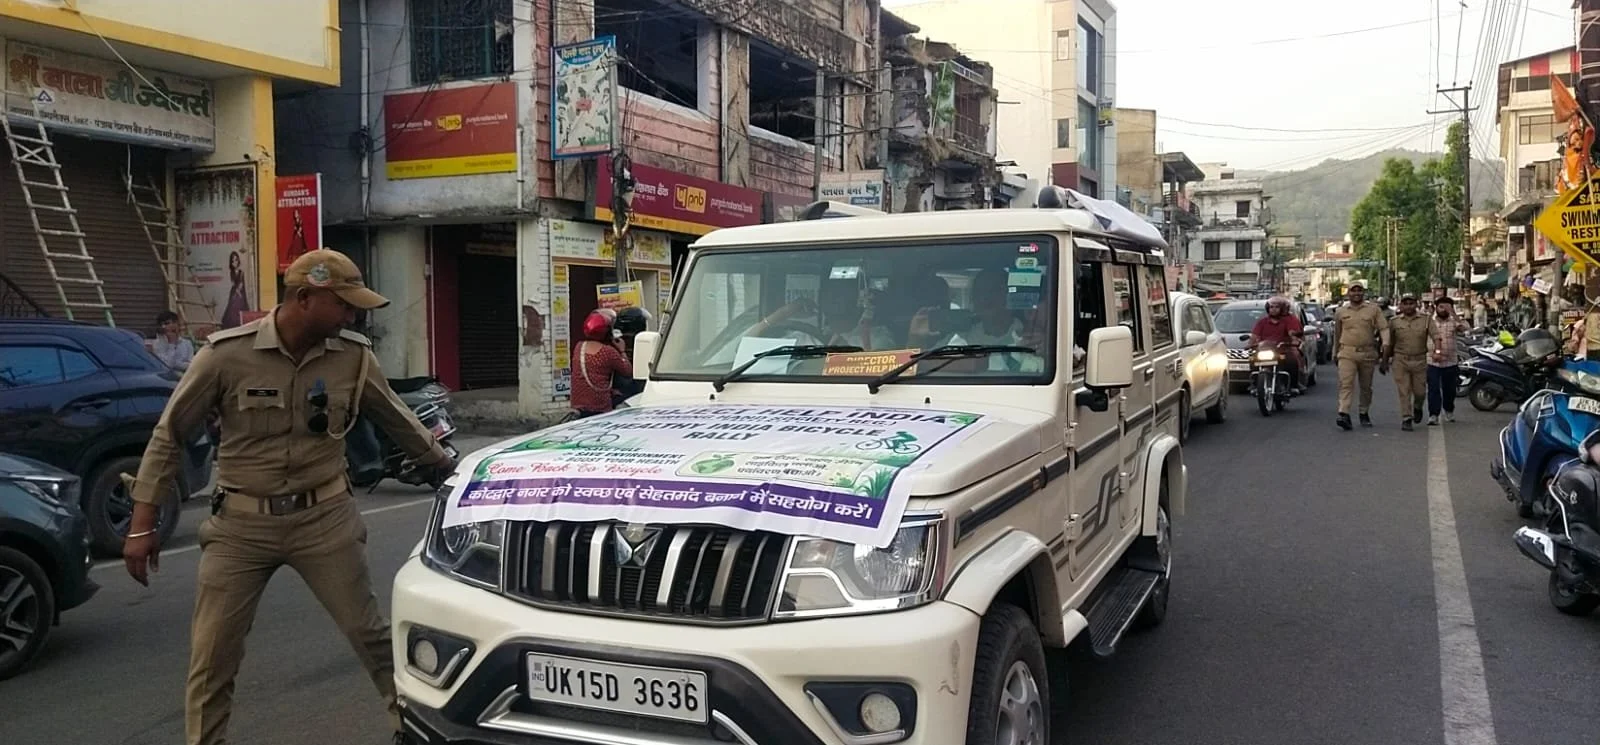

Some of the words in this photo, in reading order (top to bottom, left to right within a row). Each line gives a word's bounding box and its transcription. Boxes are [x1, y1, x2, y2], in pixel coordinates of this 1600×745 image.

[43, 67, 104, 99] बाला
[278, 196, 316, 208] ATTRACTION
[688, 189, 704, 207] pnb
[190, 231, 240, 245] ATTRACTION
[828, 364, 865, 374] PROJECT
[865, 364, 889, 373] HELP
[758, 408, 843, 416] HELP
[846, 411, 945, 424] INDIA
[605, 422, 706, 430] HEALTHY
[707, 423, 773, 432] INDIA
[778, 424, 885, 437] BICYCLE
[682, 431, 760, 441] RALLY
[468, 486, 515, 500] कोटद्वार
[517, 486, 551, 498] नगर
[552, 483, 573, 497] को
[573, 486, 613, 499] स्वच्छ
[614, 485, 640, 500] एवं
[639, 485, 702, 503] सेहतमंद
[750, 490, 771, 506] में
[768, 493, 833, 513] सहयोग
[545, 665, 619, 702] UK15D
[633, 677, 698, 712] 3636
